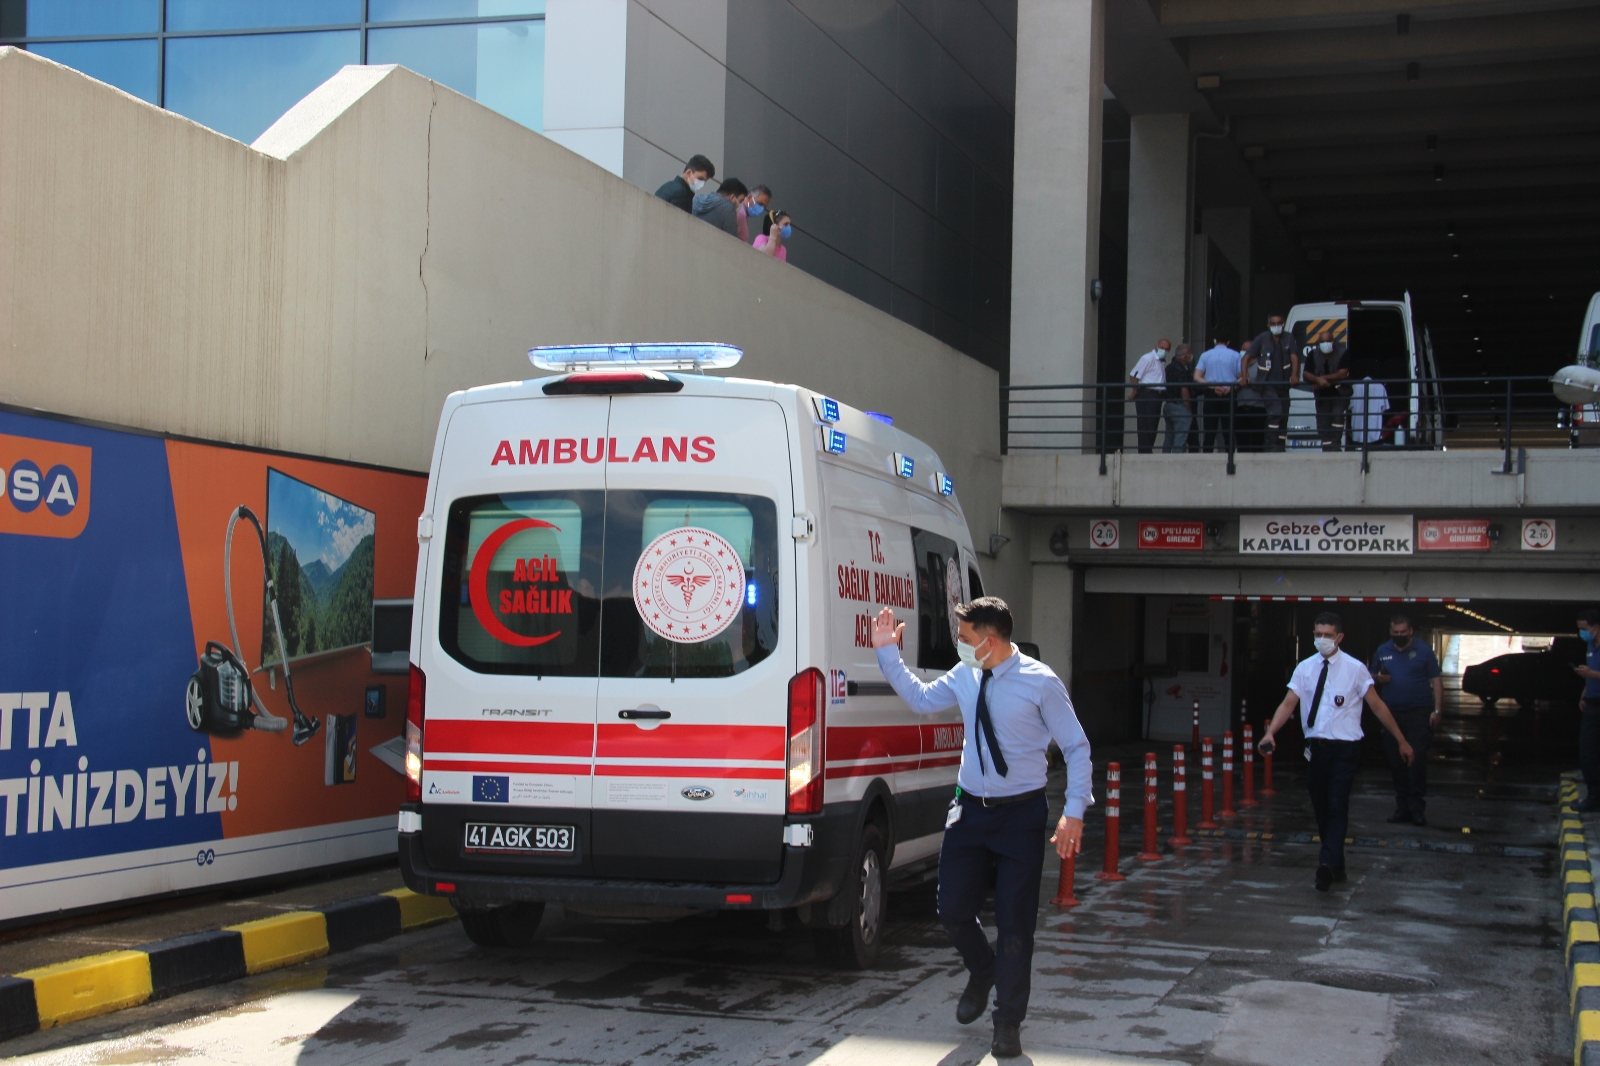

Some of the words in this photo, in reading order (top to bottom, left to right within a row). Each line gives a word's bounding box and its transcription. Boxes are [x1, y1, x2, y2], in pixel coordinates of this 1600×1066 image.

[490, 435, 716, 466] AMBULANS
[0, 466, 76, 507] SA
[1266, 521, 1321, 536] Gebze
[1322, 516, 1386, 538] Center
[868, 530, 885, 565] T.C.
[1242, 538, 1310, 551] KAPALI
[1317, 538, 1411, 552] OTOPARK
[513, 554, 559, 582] ACİL
[499, 585, 573, 614] SAĞLIK
[837, 560, 871, 602] SAĞLIK
[873, 572, 915, 610] BAKANLIĞI
[830, 669, 846, 698] 112
[0, 691, 78, 750] TTA
[481, 708, 553, 717] TRANSIT
[0, 747, 239, 837] TİNİZDEYİZ!
[469, 826, 486, 846] 41
[490, 826, 532, 848] AGK
[535, 828, 569, 849] 503
